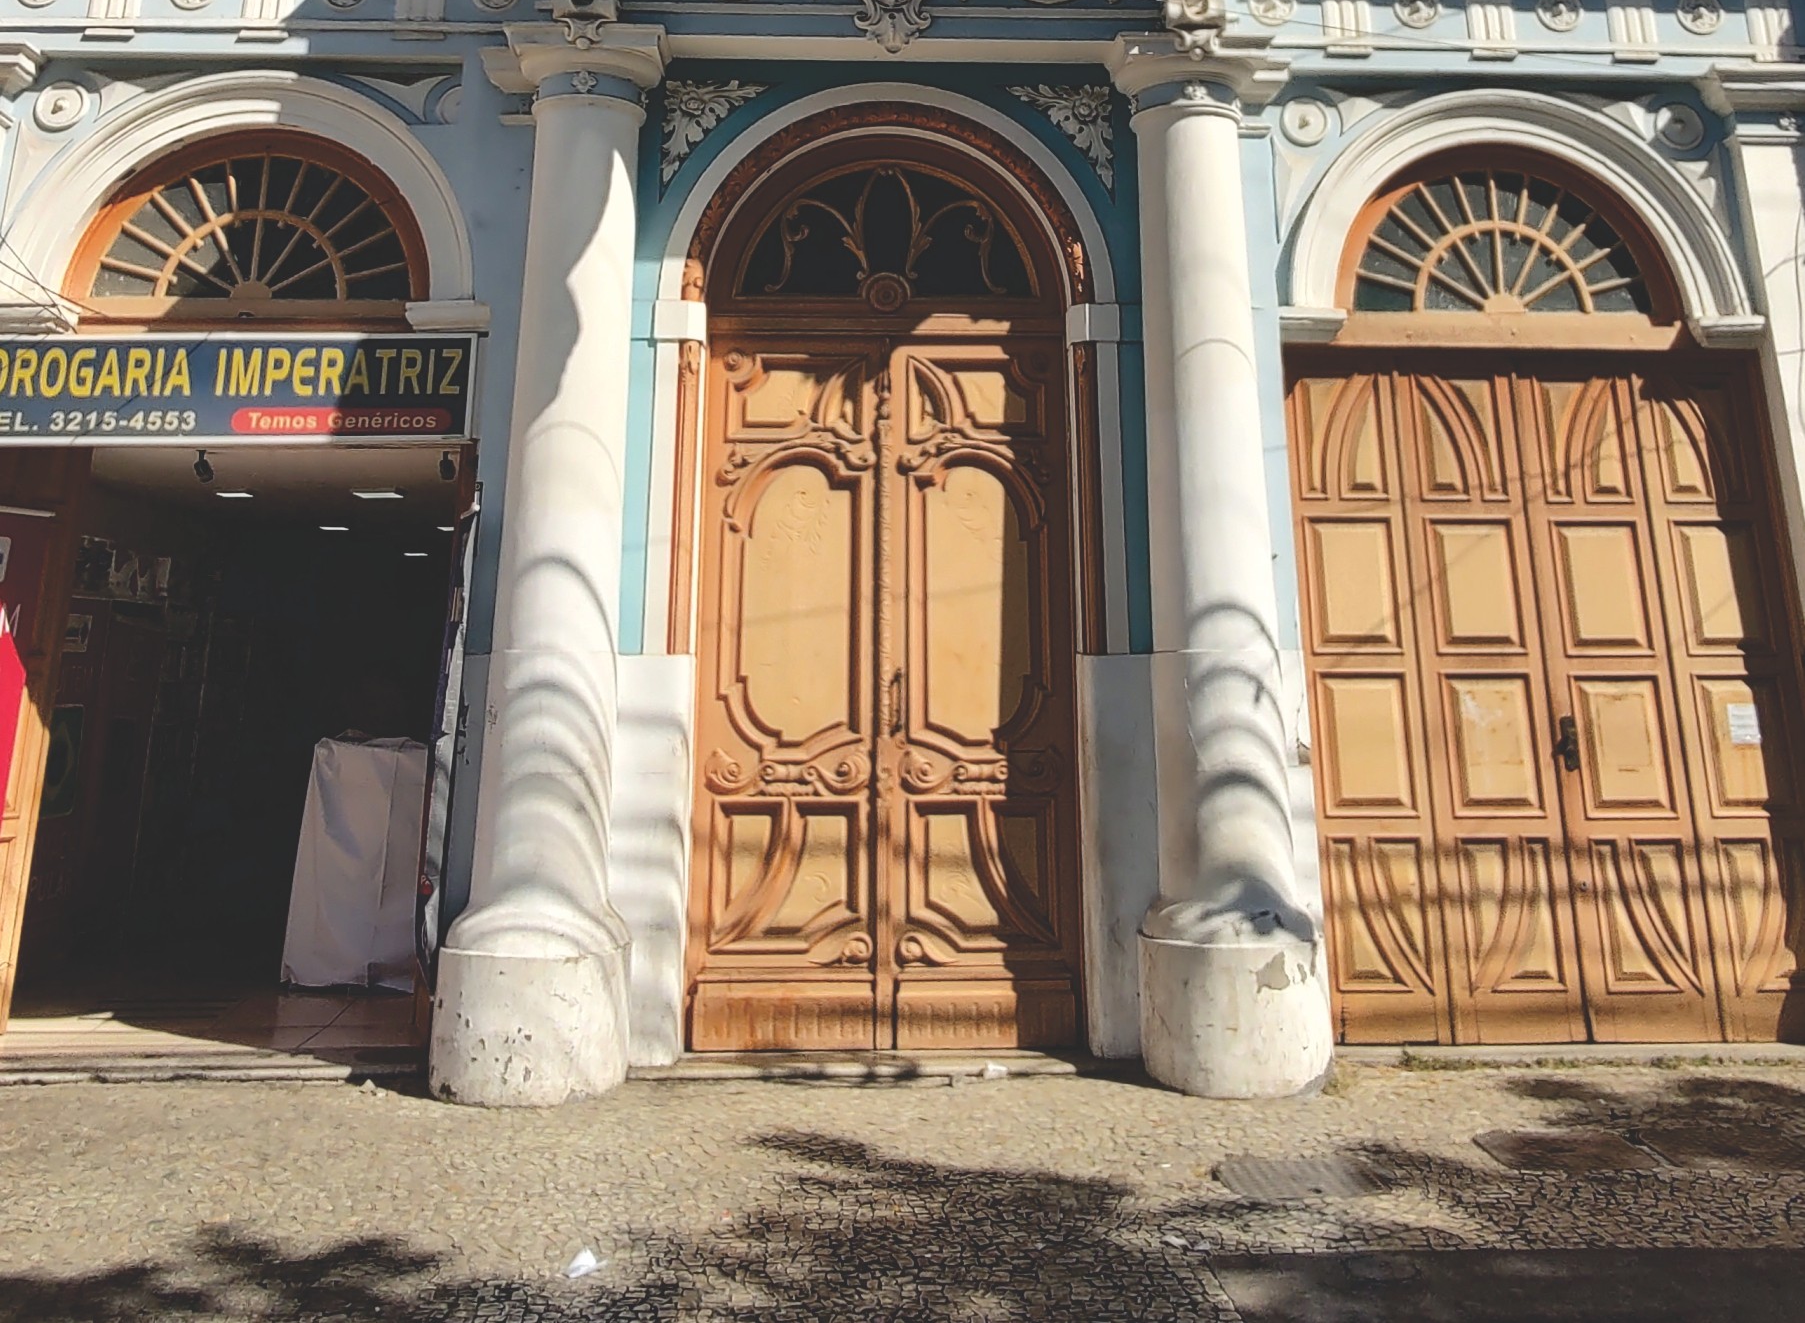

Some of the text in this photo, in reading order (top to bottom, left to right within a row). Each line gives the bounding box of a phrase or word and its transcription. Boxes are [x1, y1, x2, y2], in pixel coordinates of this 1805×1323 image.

[214, 347, 463, 396] IMPERATRIZ
[50, 410, 196, 431] 3215-4553
[248, 411, 437, 429] Temos Genéricos
